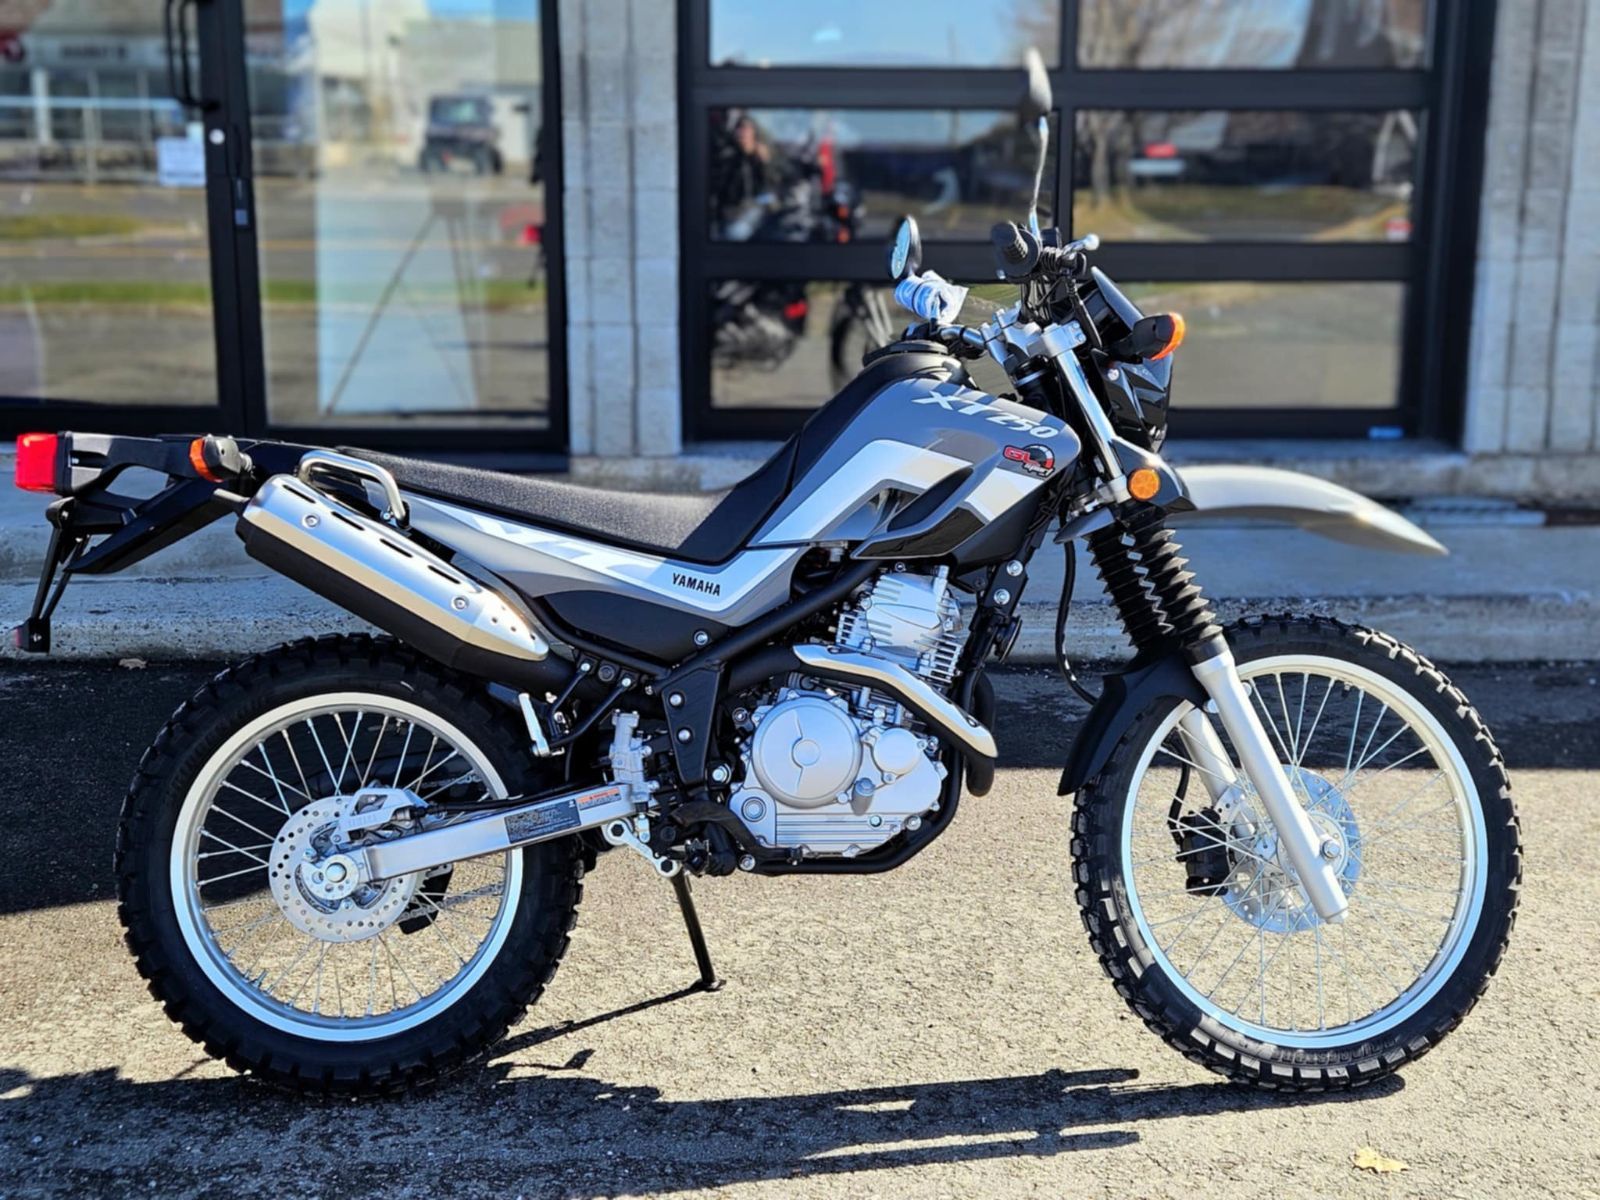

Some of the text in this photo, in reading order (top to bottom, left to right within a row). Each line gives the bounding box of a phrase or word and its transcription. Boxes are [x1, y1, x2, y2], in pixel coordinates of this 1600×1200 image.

[911, 386, 1059, 439] XT250
[1004, 446, 1041, 467] GL
[672, 573, 721, 596] YAMAHA
